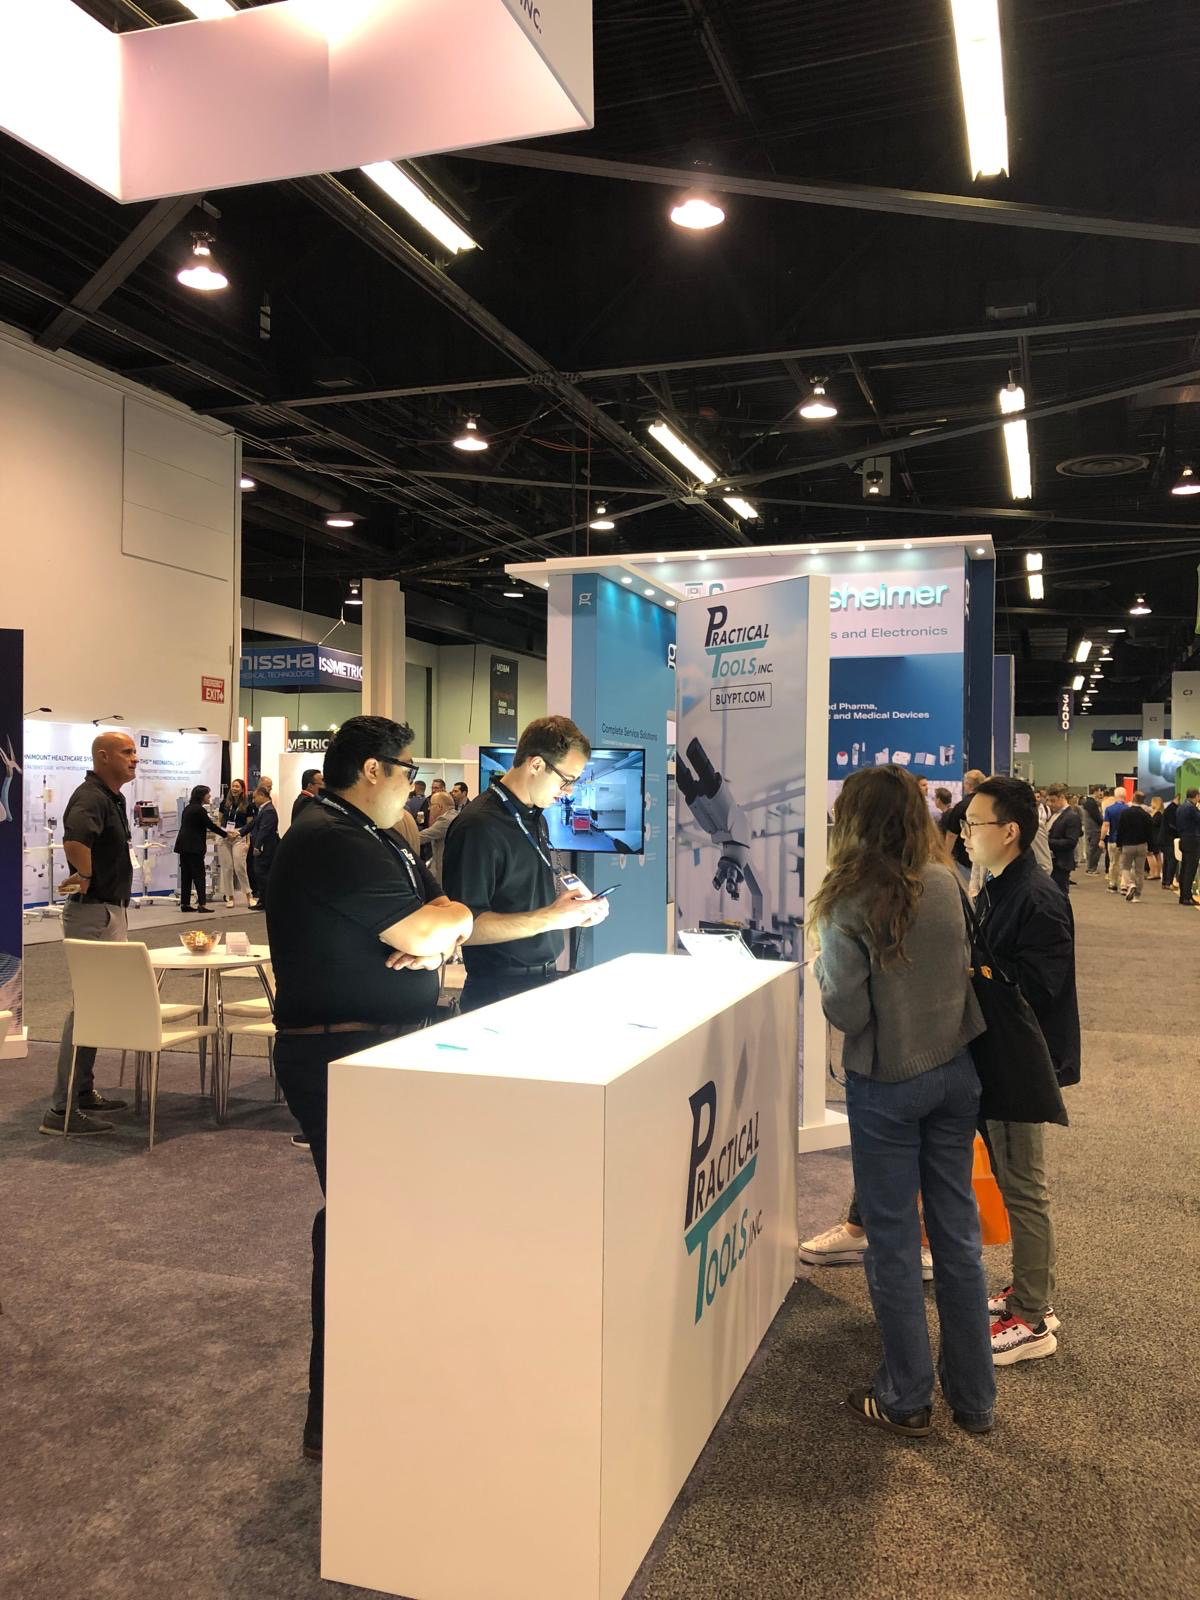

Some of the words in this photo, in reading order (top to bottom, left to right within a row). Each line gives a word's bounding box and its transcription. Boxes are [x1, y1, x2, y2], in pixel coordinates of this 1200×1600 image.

[520, 0, 542, 34] NC.
[704, 605, 769, 648] PRACTICAL
[842, 629, 867, 639] and
[871, 626, 948, 638] Electronics
[206, 687, 221, 700] EXIT
[715, 690, 766, 705] BUYPT.COM
[839, 702, 878, 711] Pharma,
[1061, 694, 1070, 730] 3400
[833, 712, 851, 720] and
[853, 711, 890, 720] Medical
[892, 711, 930, 719] Devices
[601, 722, 624, 736] Complete
[624, 727, 640, 739] Service
[640, 730, 658, 741] Solutions
[684, 1080, 760, 1231] PRACTICAL
